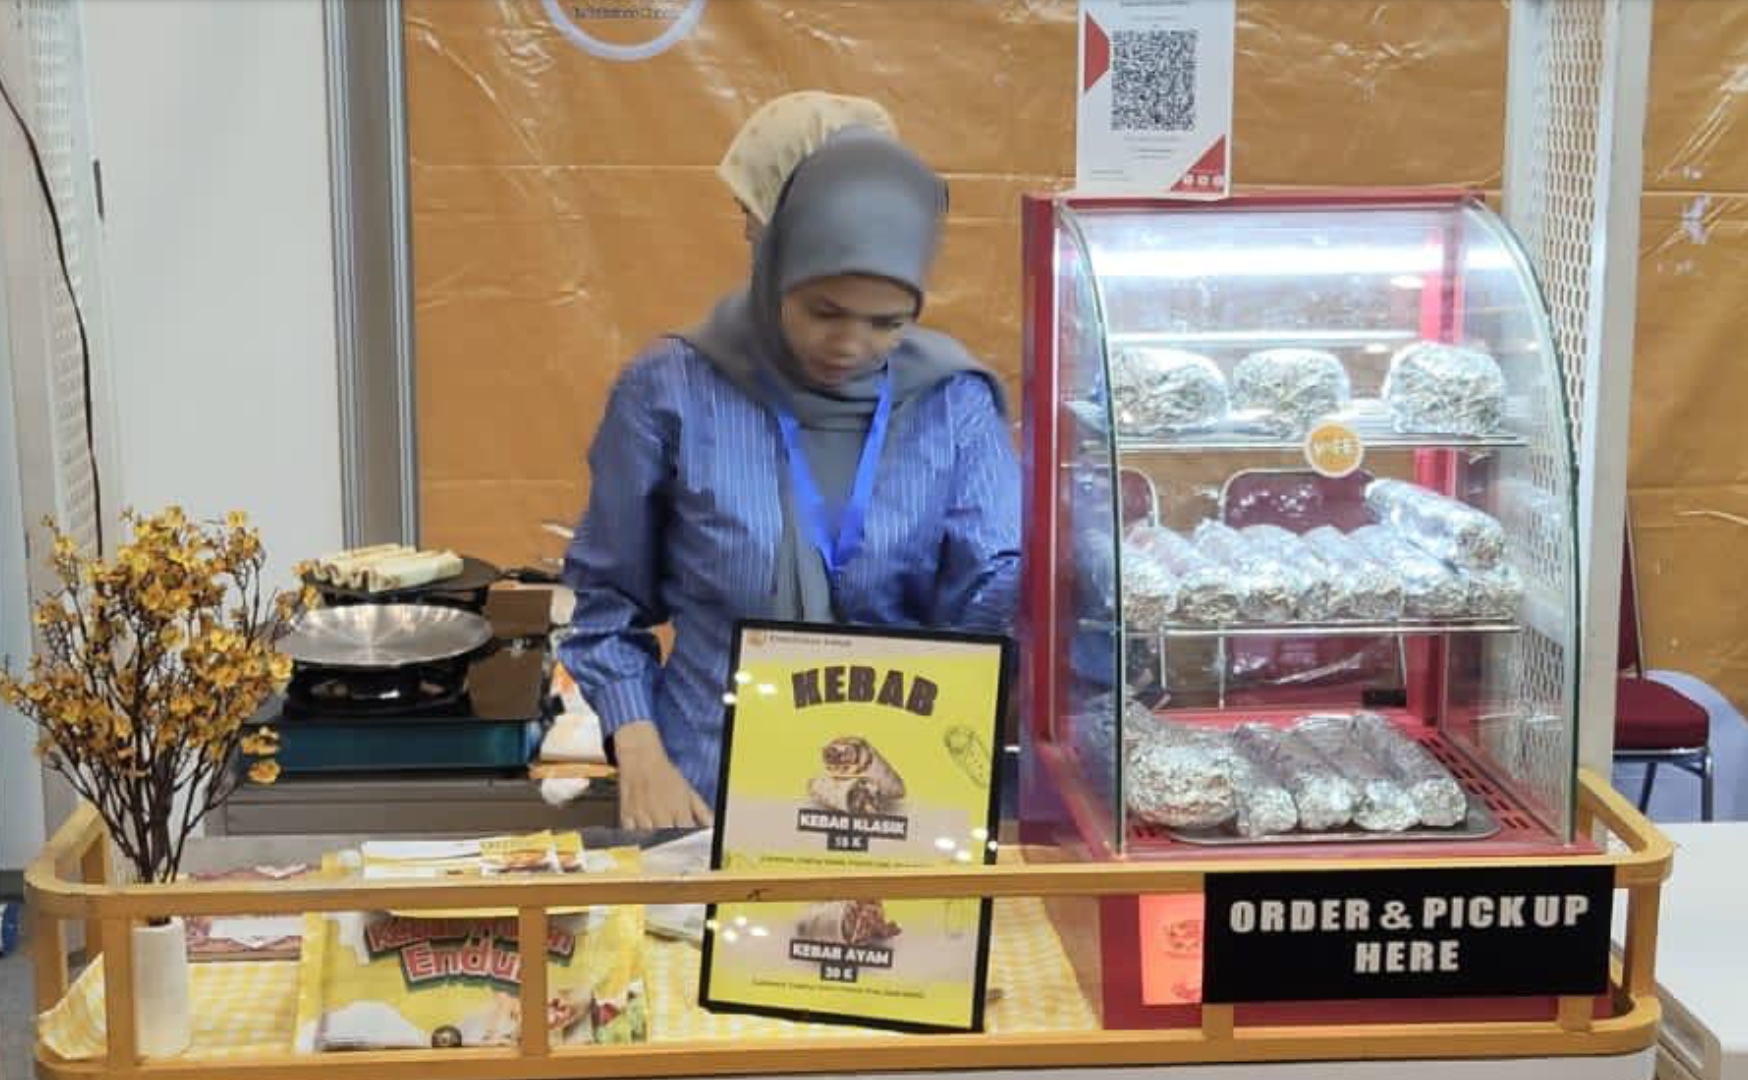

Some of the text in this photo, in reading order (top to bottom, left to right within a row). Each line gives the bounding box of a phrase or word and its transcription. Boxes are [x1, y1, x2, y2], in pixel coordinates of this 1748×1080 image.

[792, 665, 938, 717] KEBAB
[800, 813, 905, 834] KEBAB KLASIK
[1229, 898, 1371, 933] ORDER
[1379, 901, 1412, 930] &
[792, 942, 889, 965] KEBAB AYAM
[1355, 940, 1461, 974] HERE
